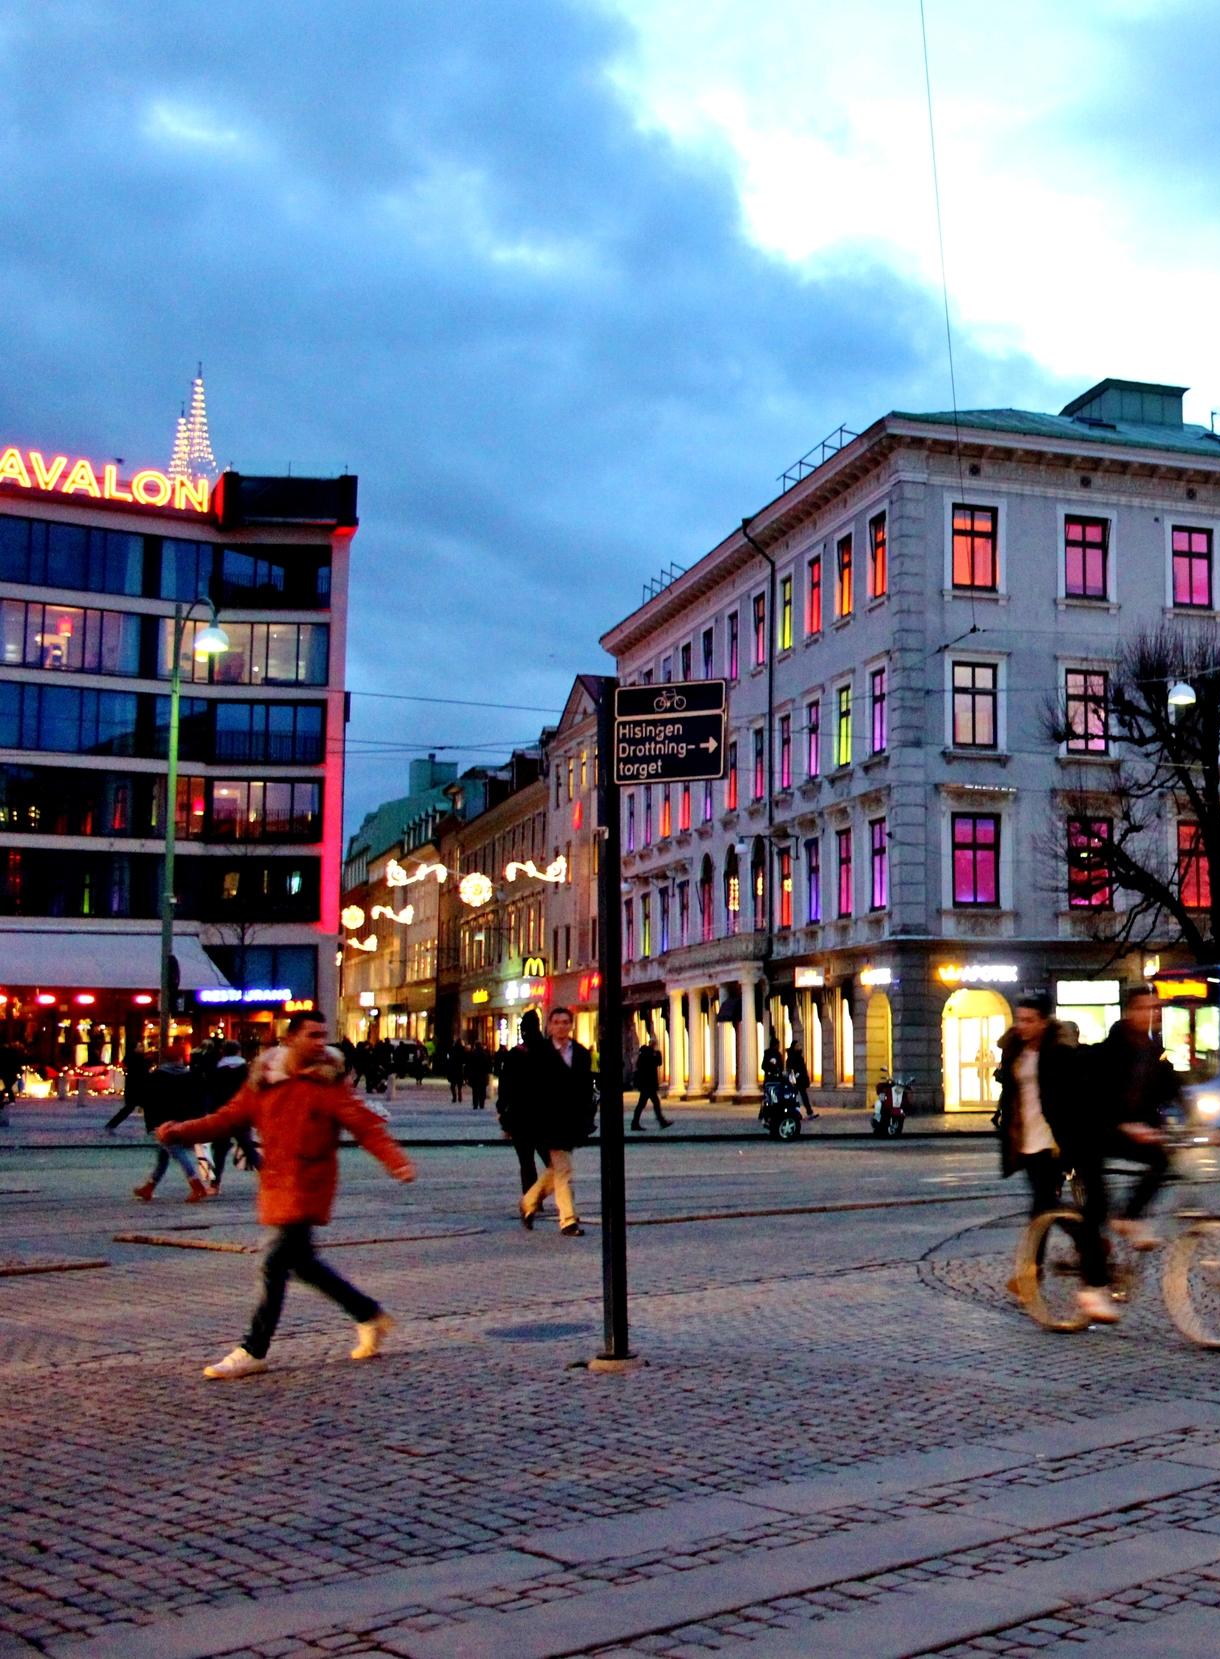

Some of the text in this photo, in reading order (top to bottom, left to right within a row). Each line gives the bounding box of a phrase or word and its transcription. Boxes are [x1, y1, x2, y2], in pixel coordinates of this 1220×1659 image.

[0, 448, 209, 513] AVALON
[619, 723, 683, 741] Hisingen
[619, 739, 696, 758] Drottning-
[619, 759, 662, 778] torget
[284, 999, 313, 1012] BAR
